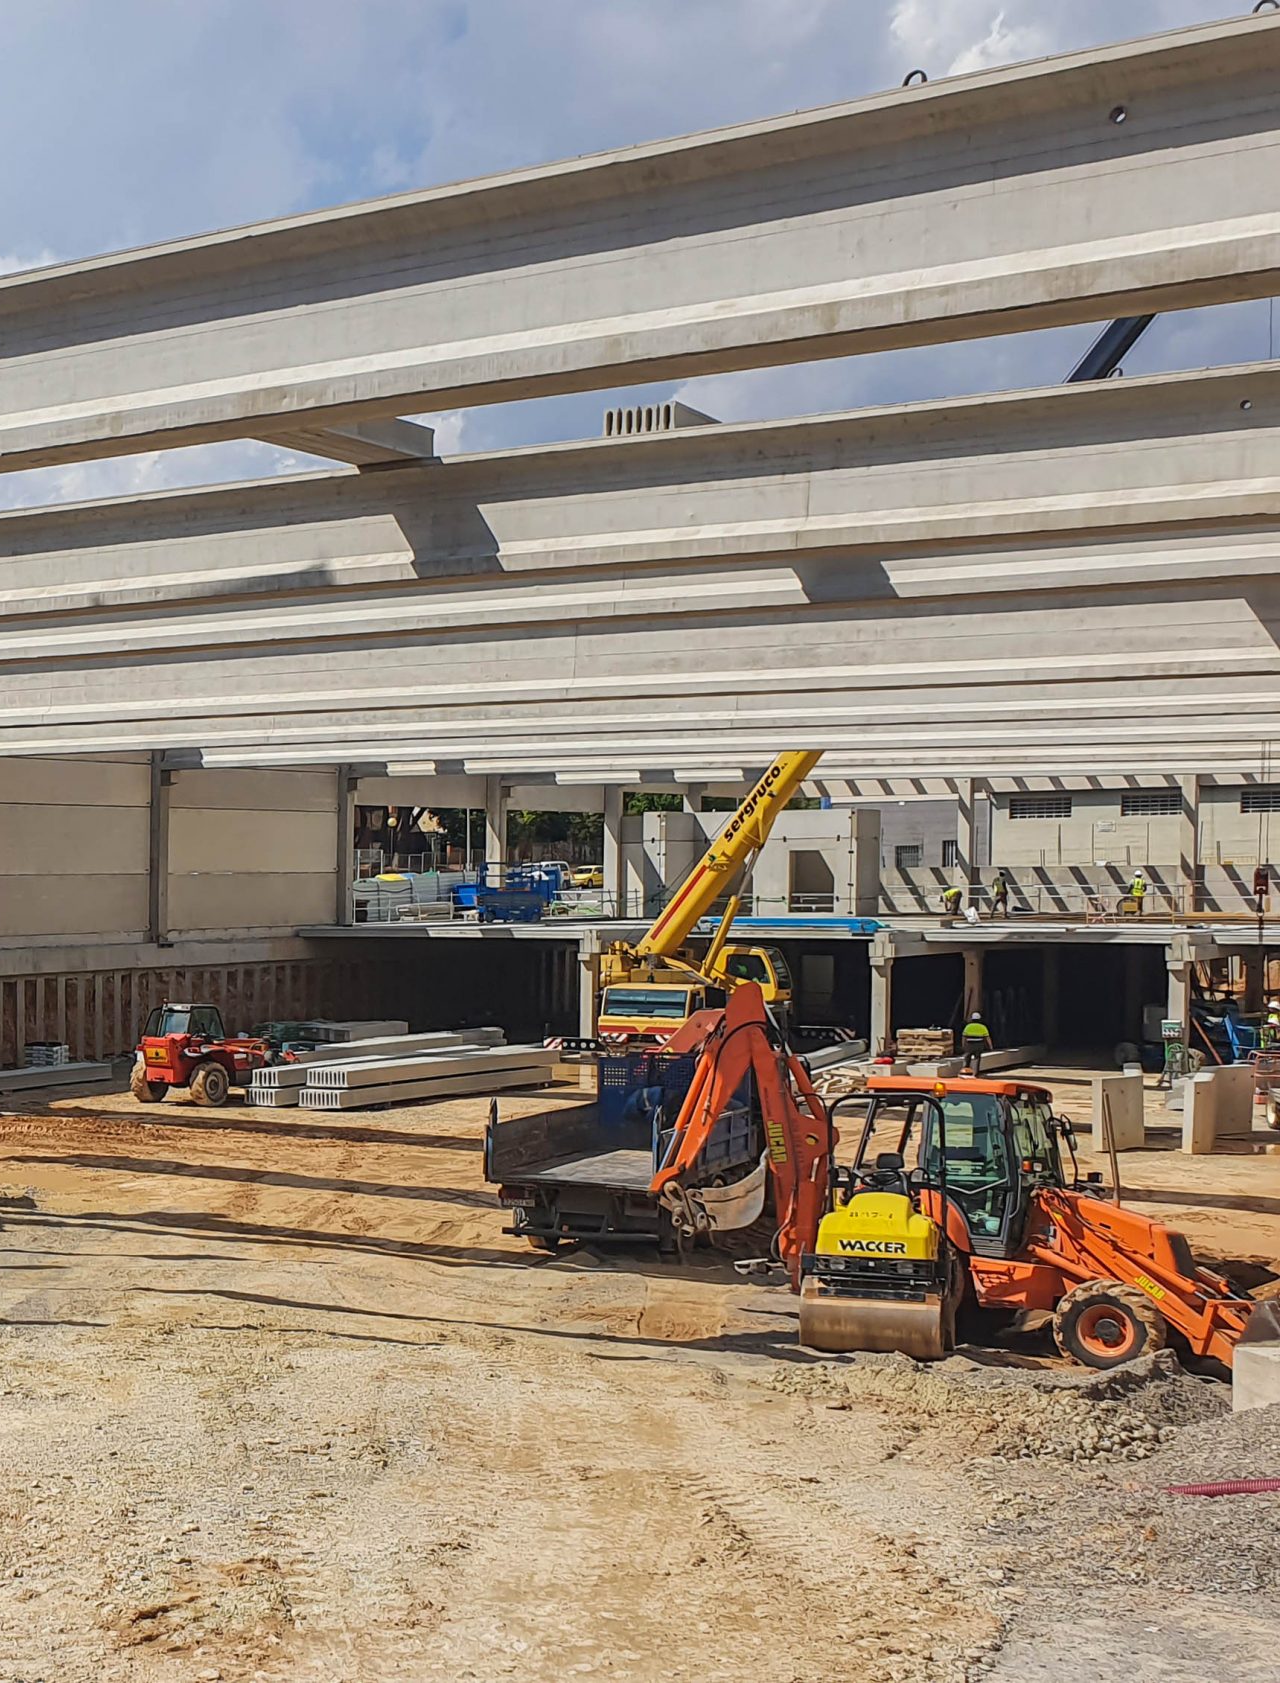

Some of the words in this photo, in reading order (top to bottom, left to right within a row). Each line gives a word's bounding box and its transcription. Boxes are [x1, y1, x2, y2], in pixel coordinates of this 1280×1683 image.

[724, 765, 781, 842] sergruco
[767, 1120, 787, 1162] JUCAR
[839, 1240, 906, 1254] WACKER
